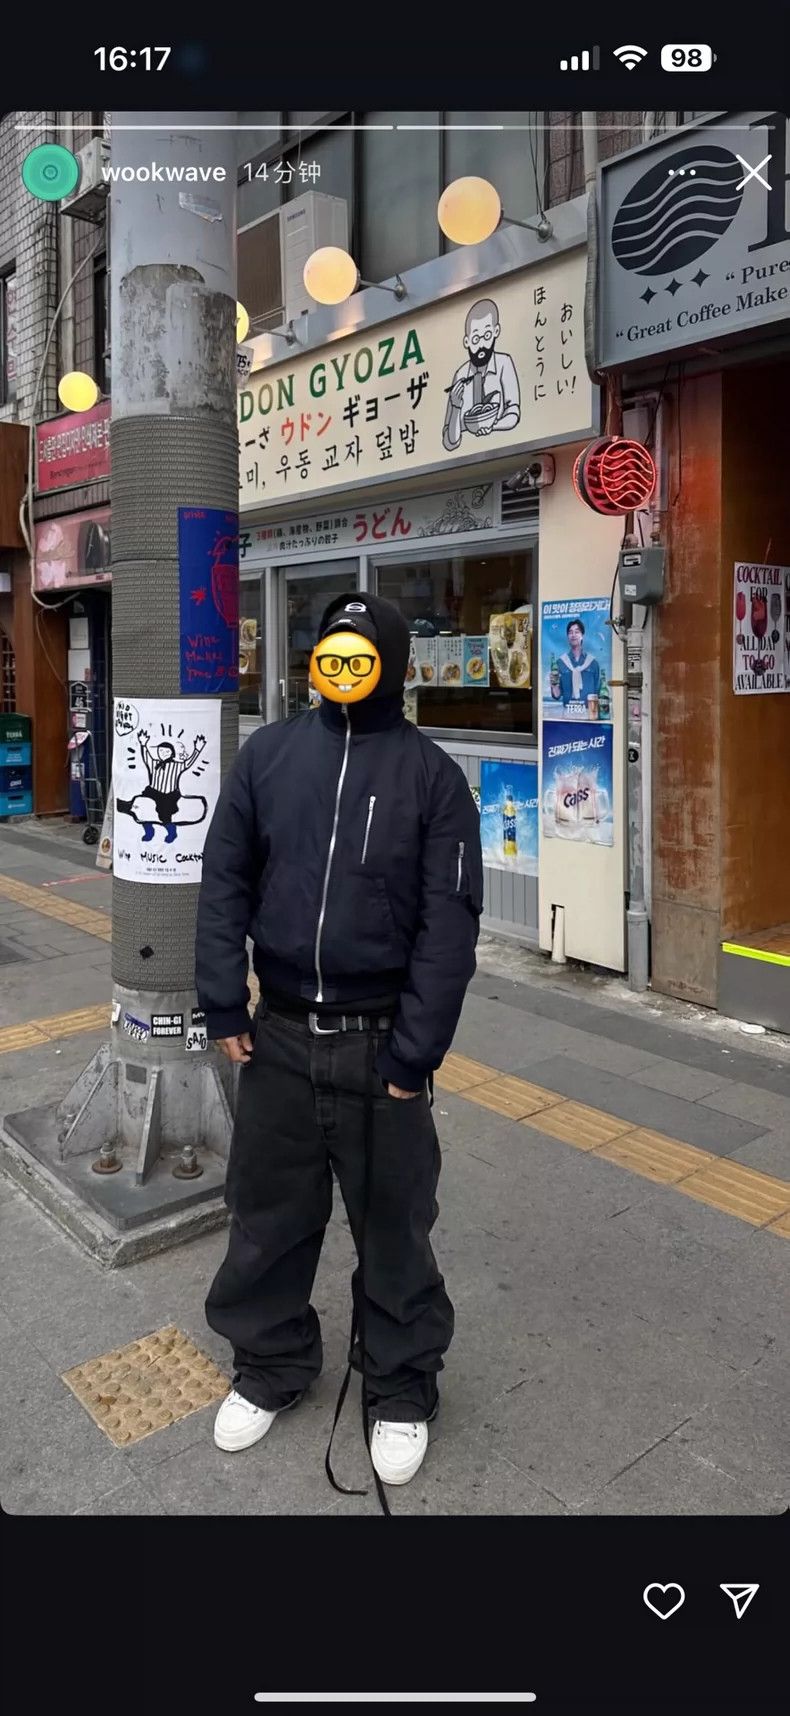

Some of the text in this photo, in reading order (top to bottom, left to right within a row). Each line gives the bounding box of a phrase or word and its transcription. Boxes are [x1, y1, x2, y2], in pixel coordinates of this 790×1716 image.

[741, 260, 790, 285] Pure
[677, 302, 731, 328] Coffee
[736, 286, 788, 312] Make
[533, 286, 547, 401] ほんとうに
[309, 328, 425, 398] GYOZA
[281, 412, 332, 445] ウドン
[343, 371, 429, 428] ギョーザ
[238, 419, 419, 489] 미, 우동 교자 덮밥
[353, 505, 411, 542] うどん
[737, 566, 782, 585] COCKTAIL
[750, 586, 768, 603] FOR
[741, 635, 757, 651] ALL
[760, 635, 776, 651] DAY
[742, 654, 775, 671] TO GO
[735, 673, 783, 690] AVAILABLE
[566, 704, 587, 714] TERRA
[153, 1016, 181, 1025] CHIN-GI
[153, 1027, 181, 1035] FOREVER
[186, 1032, 206, 1049] SATO
